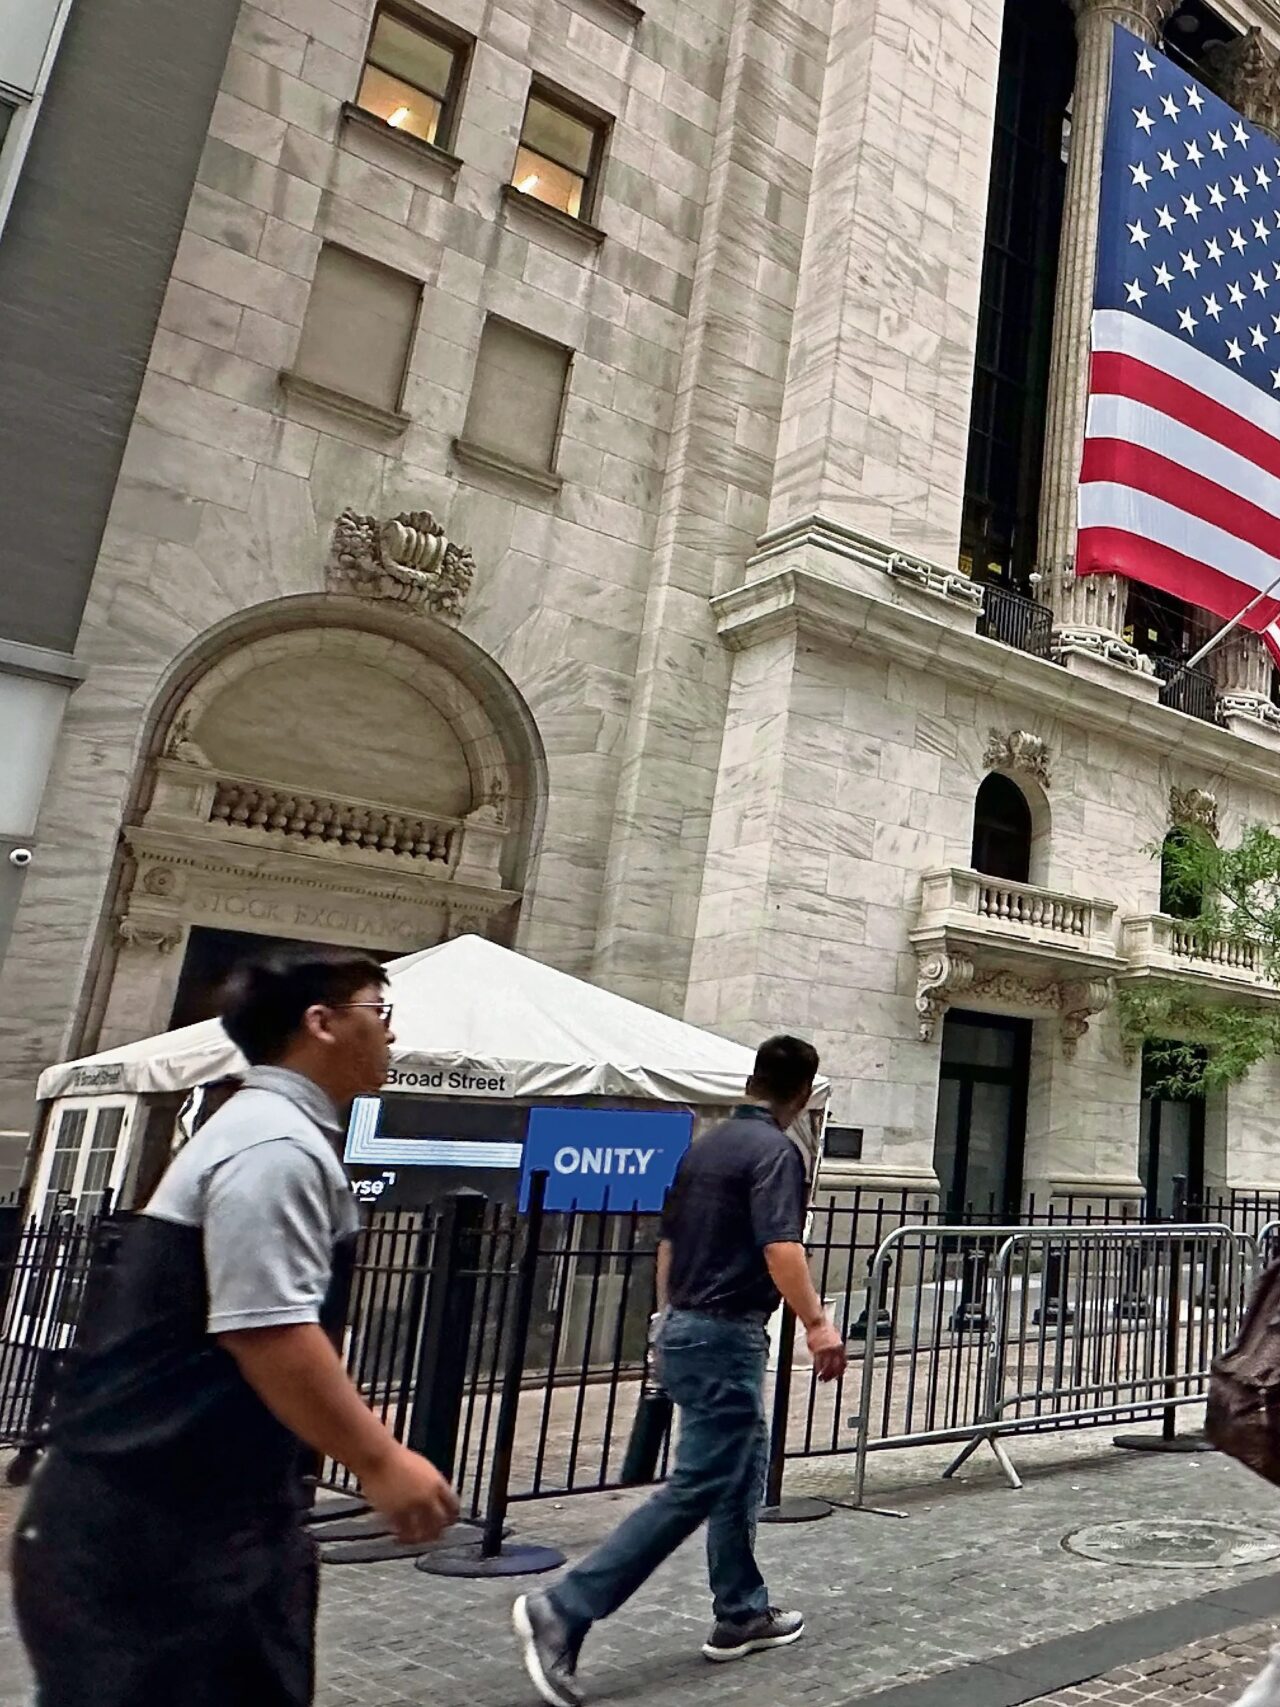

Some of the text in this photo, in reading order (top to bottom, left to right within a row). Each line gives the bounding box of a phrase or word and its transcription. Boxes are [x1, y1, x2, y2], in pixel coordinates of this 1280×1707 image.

[193, 895, 282, 923] STOCK
[385, 1069, 505, 1091] Broad Street
[351, 1180, 384, 1196] yse
